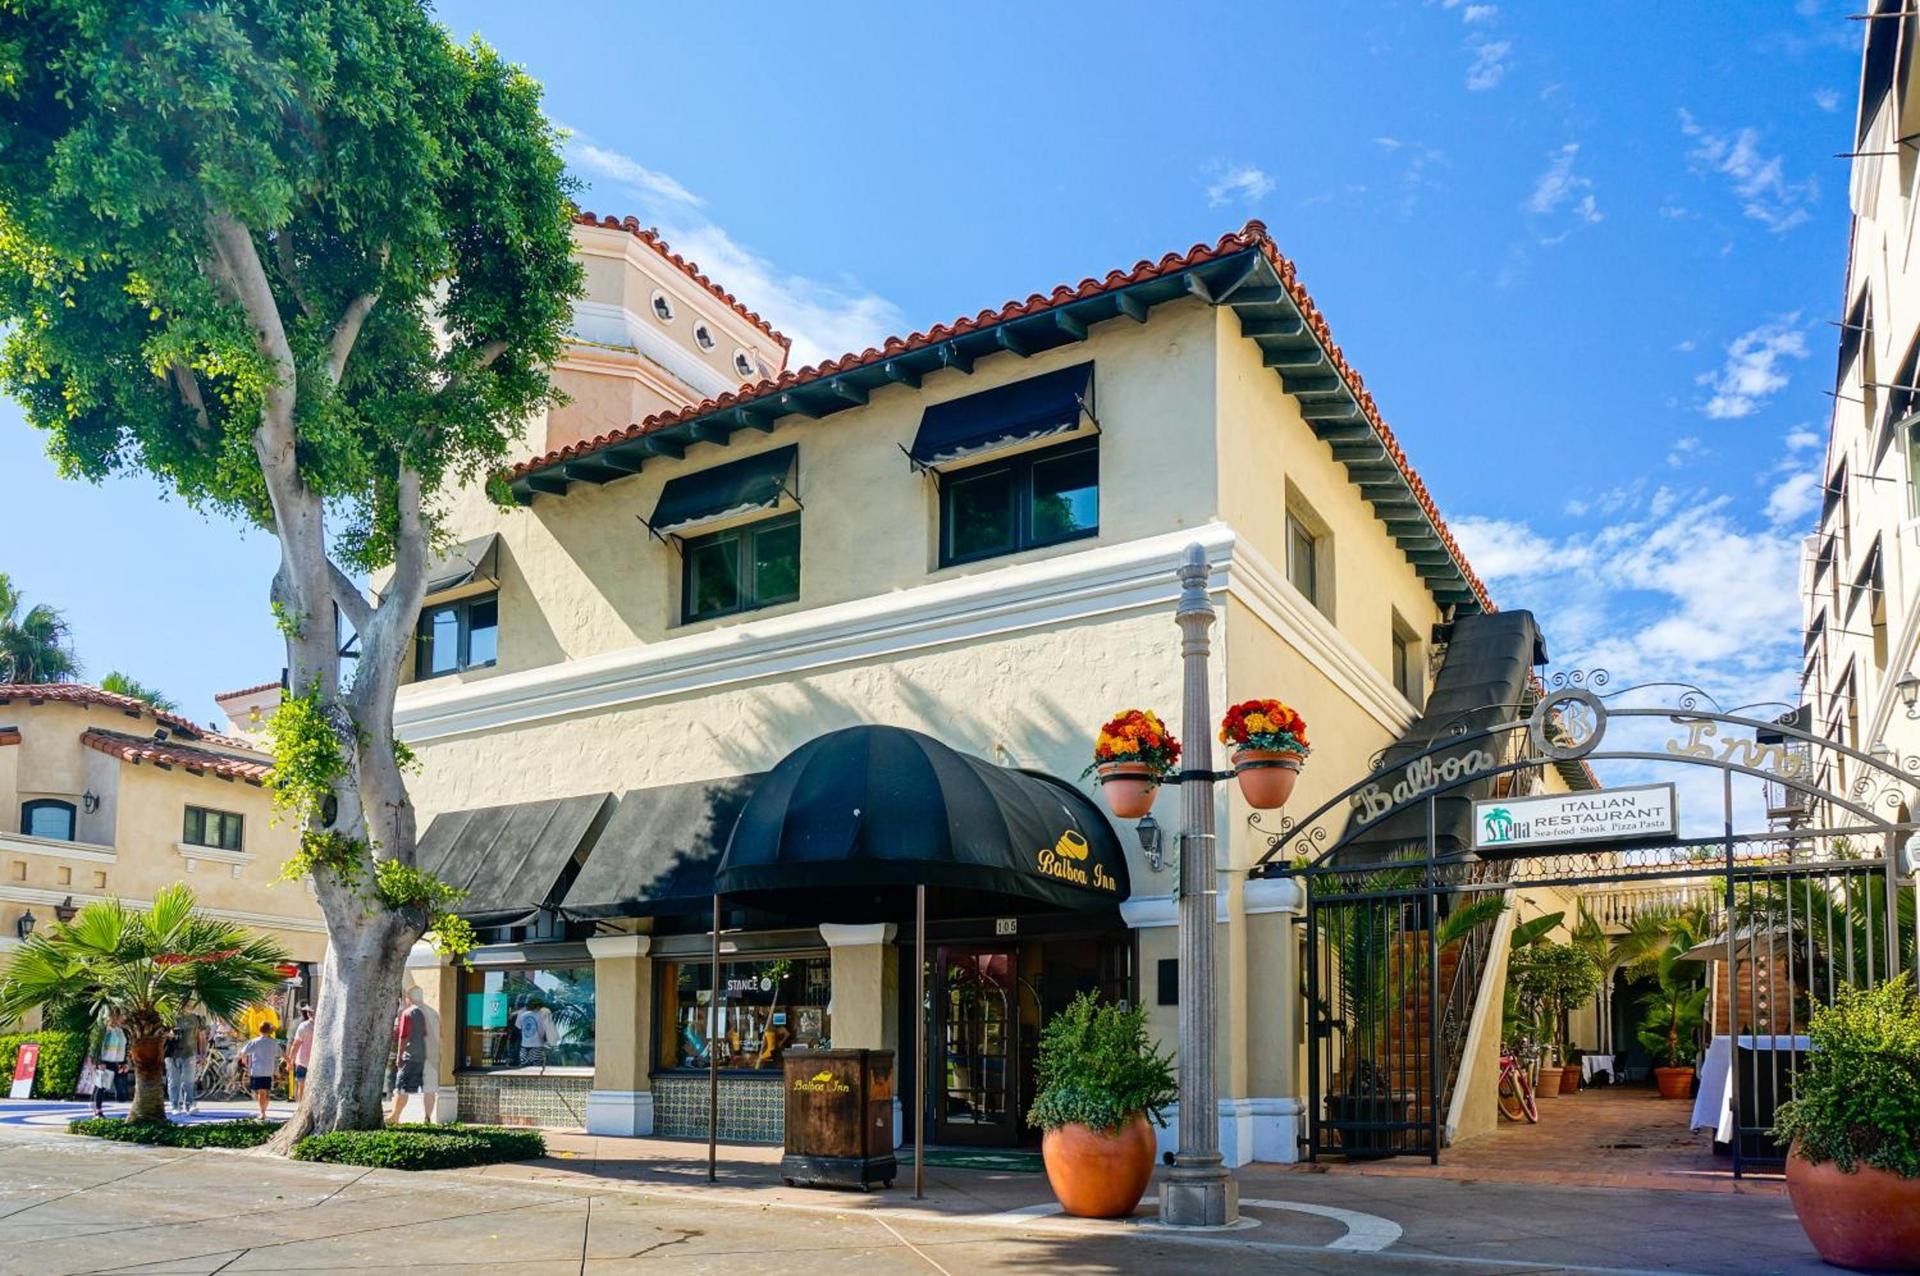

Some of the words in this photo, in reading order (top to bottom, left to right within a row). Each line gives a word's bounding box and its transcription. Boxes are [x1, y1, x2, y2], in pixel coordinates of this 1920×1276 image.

[1349, 749, 1496, 824] Balboa
[1665, 716, 1802, 779] Inn
[1561, 797, 1636, 813] ITALIAN
[1534, 807, 1665, 828] RESTAURANT
[1534, 826, 1575, 838] Sea-food
[1579, 824, 1606, 834] Steak
[1611, 822, 1637, 832] Pizza
[1640, 819, 1665, 830] Pasta
[1038, 849, 1087, 885] Balboa
[1093, 863, 1116, 891] Inn
[998, 920, 1016, 933] 105
[727, 979, 759, 991] STANCE
[793, 1079, 825, 1092] Balboa
[832, 1080, 850, 1092] Inn
